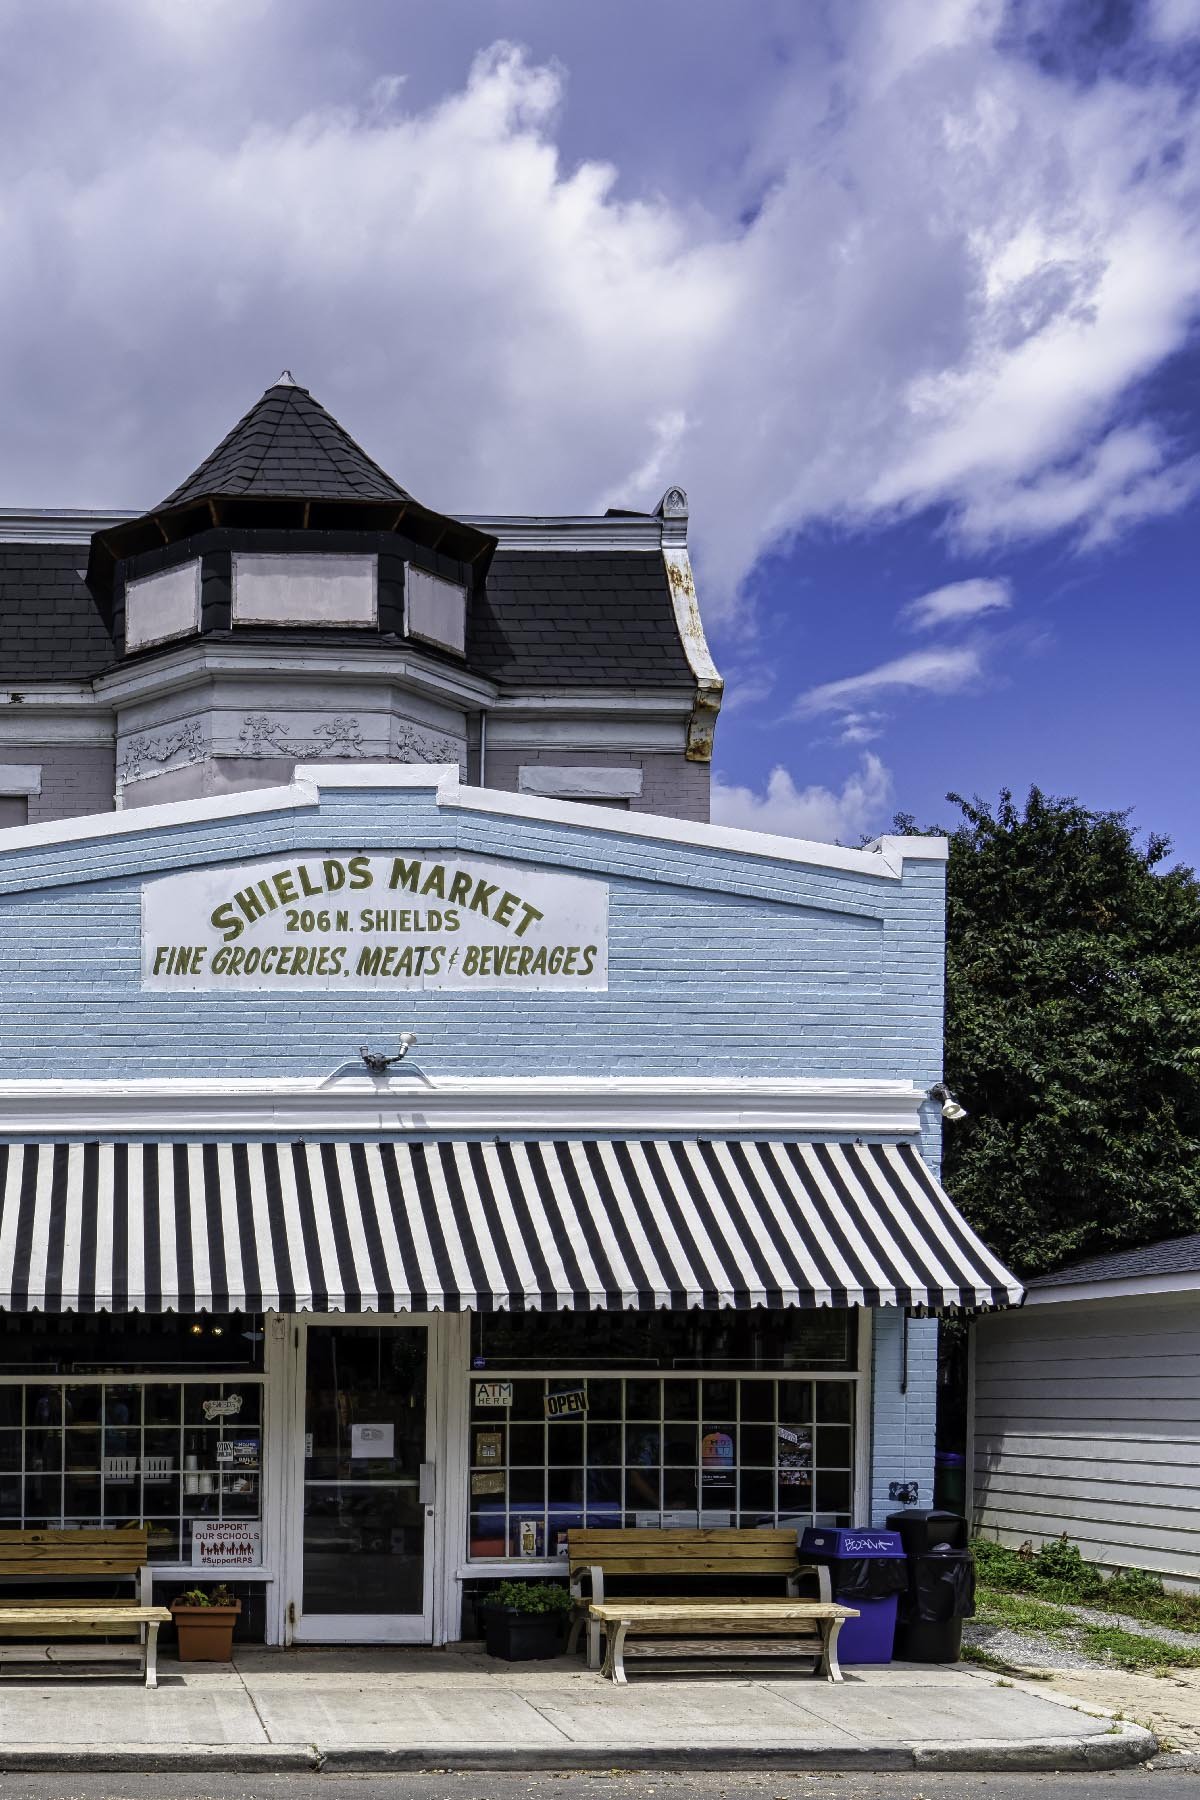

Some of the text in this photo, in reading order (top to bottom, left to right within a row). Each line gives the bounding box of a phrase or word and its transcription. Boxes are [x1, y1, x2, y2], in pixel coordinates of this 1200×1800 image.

[210, 857, 544, 942] SHIELDS MARKET
[286, 909, 460, 933] 206 N. SHIELDS
[152, 946, 206, 976] FINE
[211, 945, 349, 978] GROCERIES,
[355, 945, 446, 977] MEATS
[461, 945, 597, 977] BEVERAGES
[477, 1384, 511, 1397] ATM
[547, 1392, 586, 1415] OPEN
[195, 1532, 260, 1540] OUR SCHOOLS
[206, 1523, 248, 1531] SUPPORT
[201, 1556, 253, 1565] #SupportRPS
